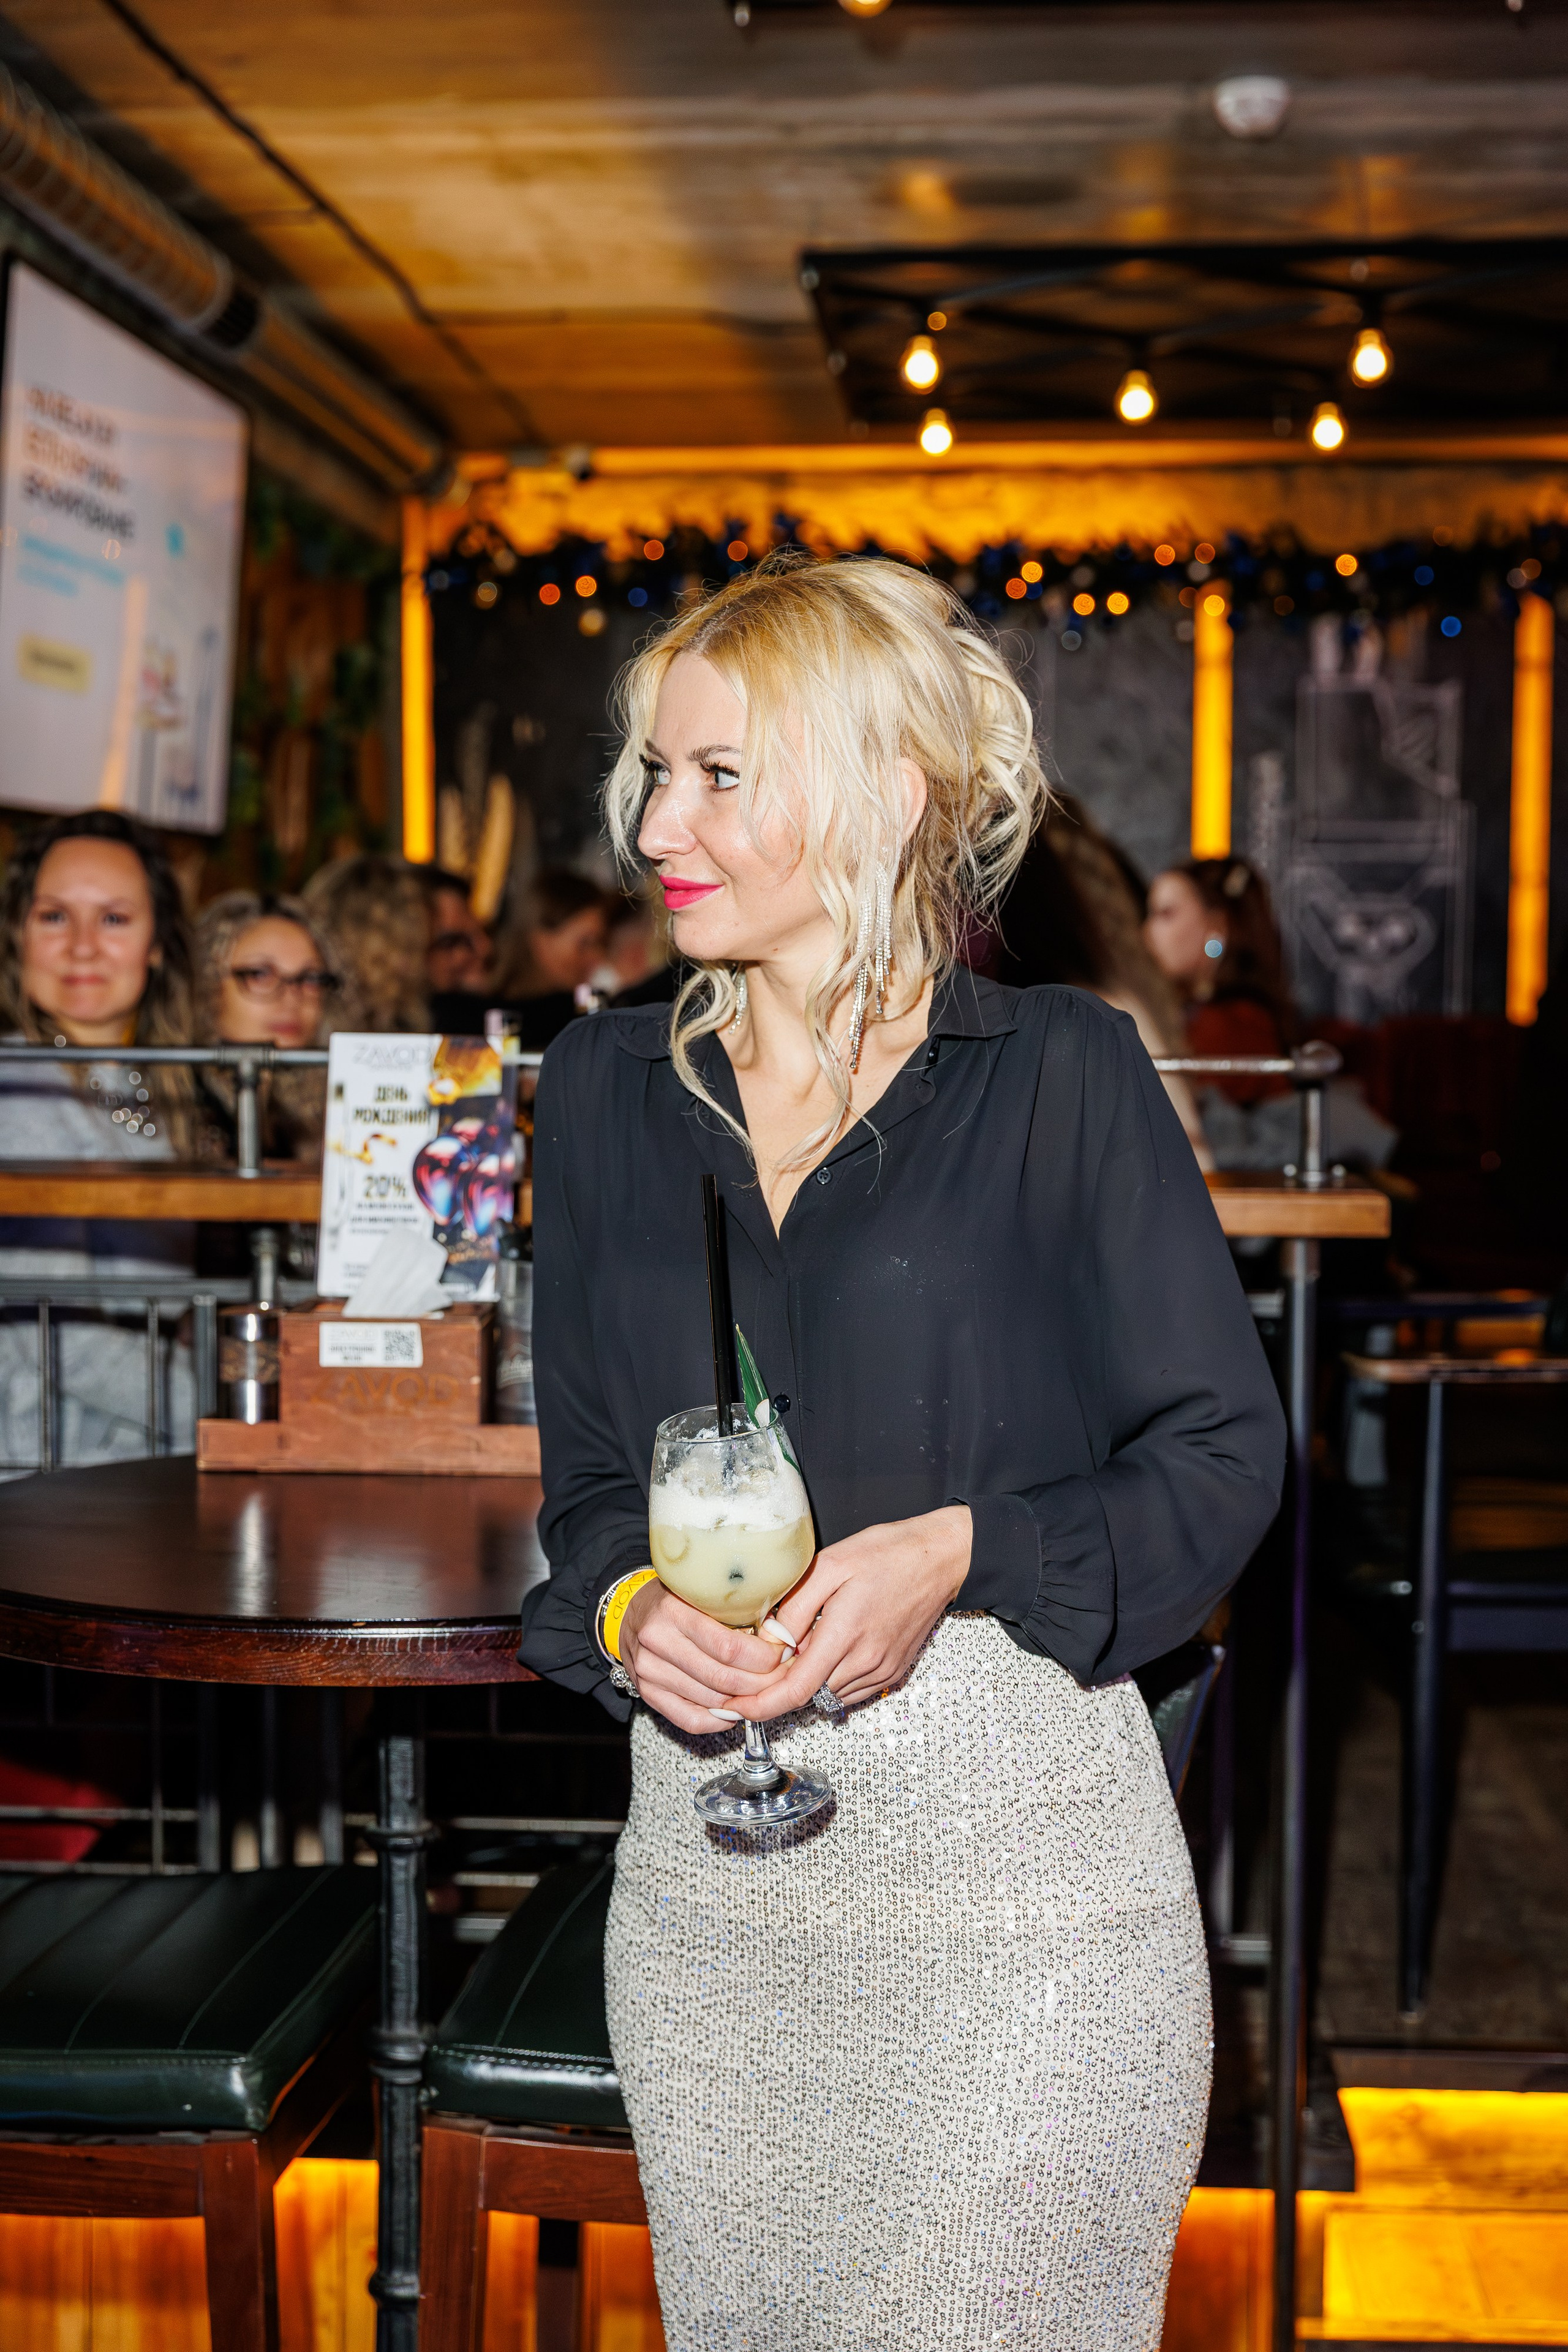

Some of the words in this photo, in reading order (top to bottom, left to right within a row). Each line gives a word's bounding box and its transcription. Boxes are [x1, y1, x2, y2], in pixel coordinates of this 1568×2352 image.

[352, 1042, 432, 1065] ZAVOD
[375, 1084, 409, 1103] ДЕНЬ
[363, 1174, 407, 1199] 20%
[310, 1371, 459, 1409] ZAVOD
